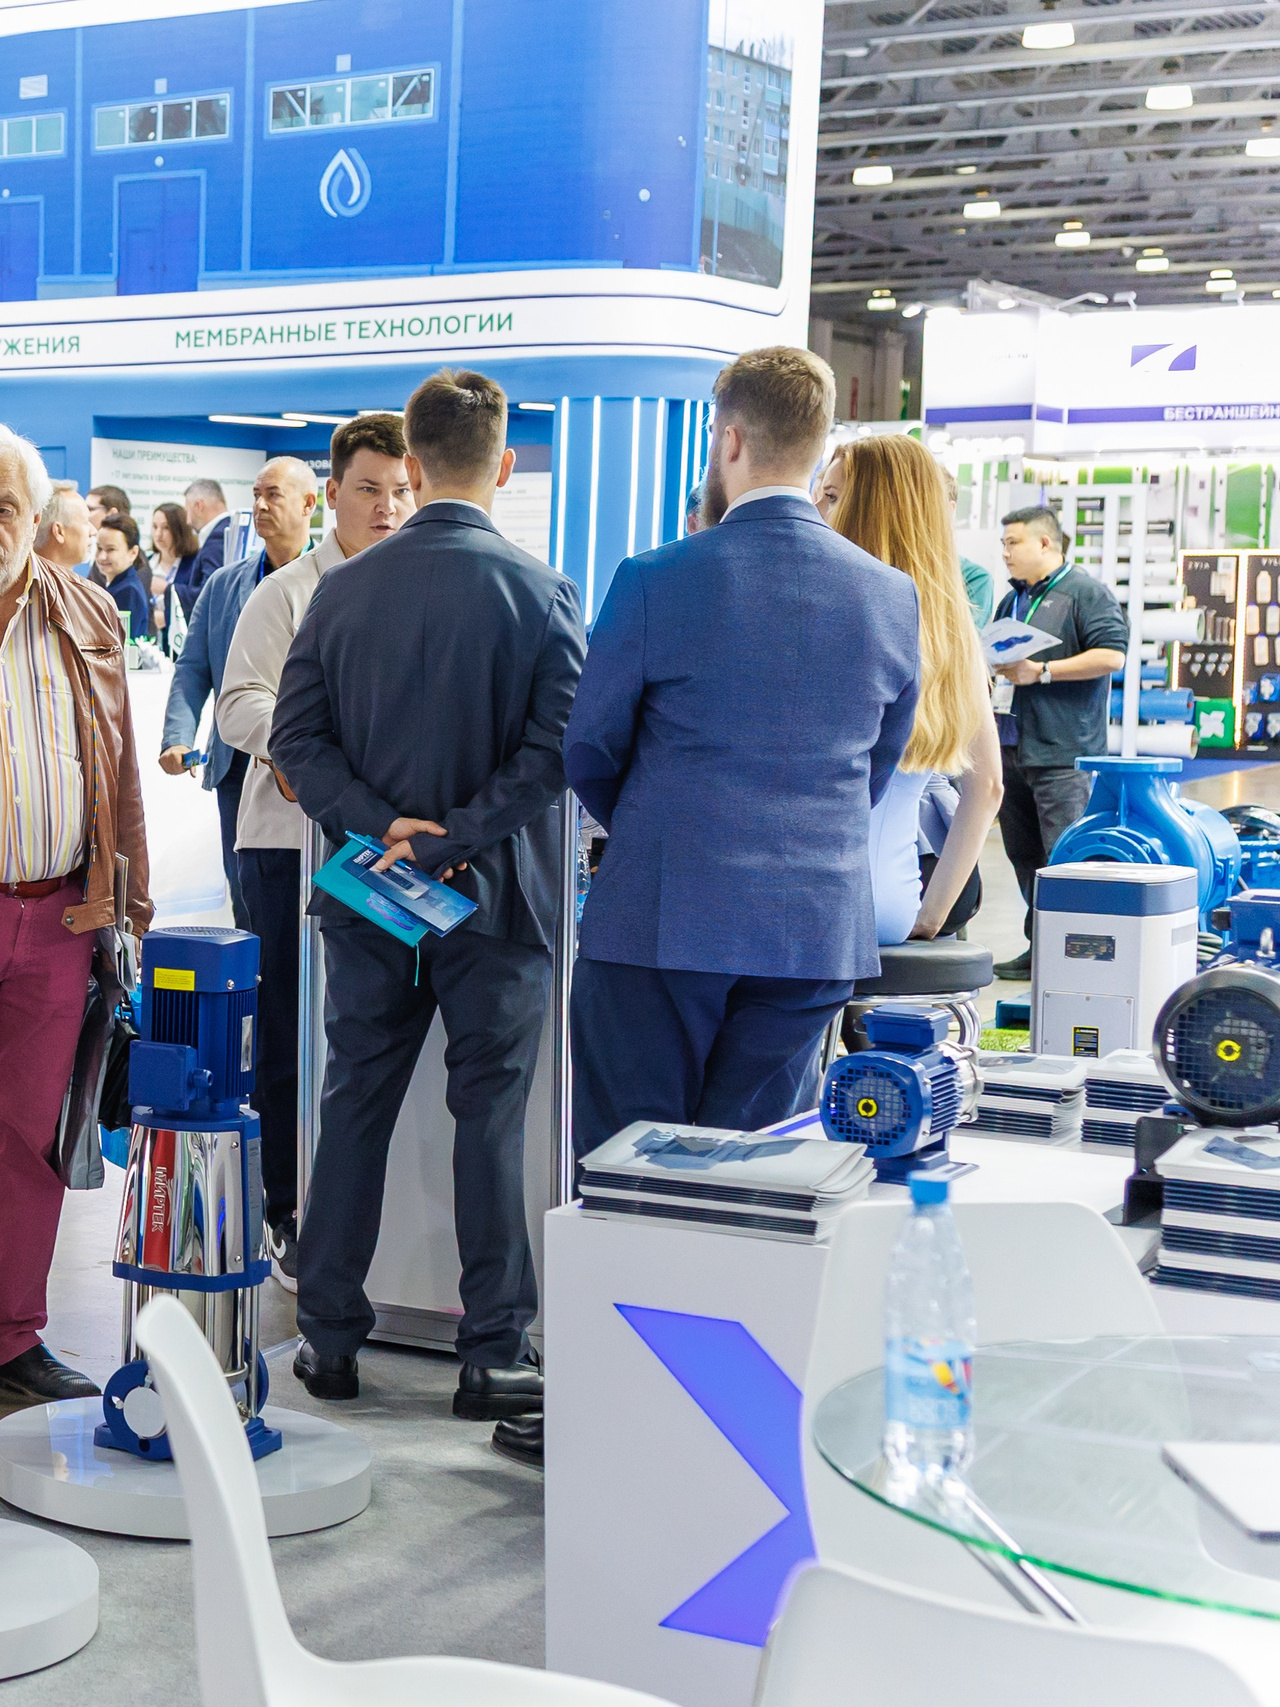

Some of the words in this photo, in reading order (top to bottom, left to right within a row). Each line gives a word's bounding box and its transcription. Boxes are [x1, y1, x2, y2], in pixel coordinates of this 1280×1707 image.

[175, 322, 337, 348] МЕМБРАННЫЕ
[343, 312, 513, 340] ТЕХНОЛОГИИ
[1163, 403, 1280, 421] БЕСТРАНШЕЙН
[112, 448, 135, 460] НАШИ
